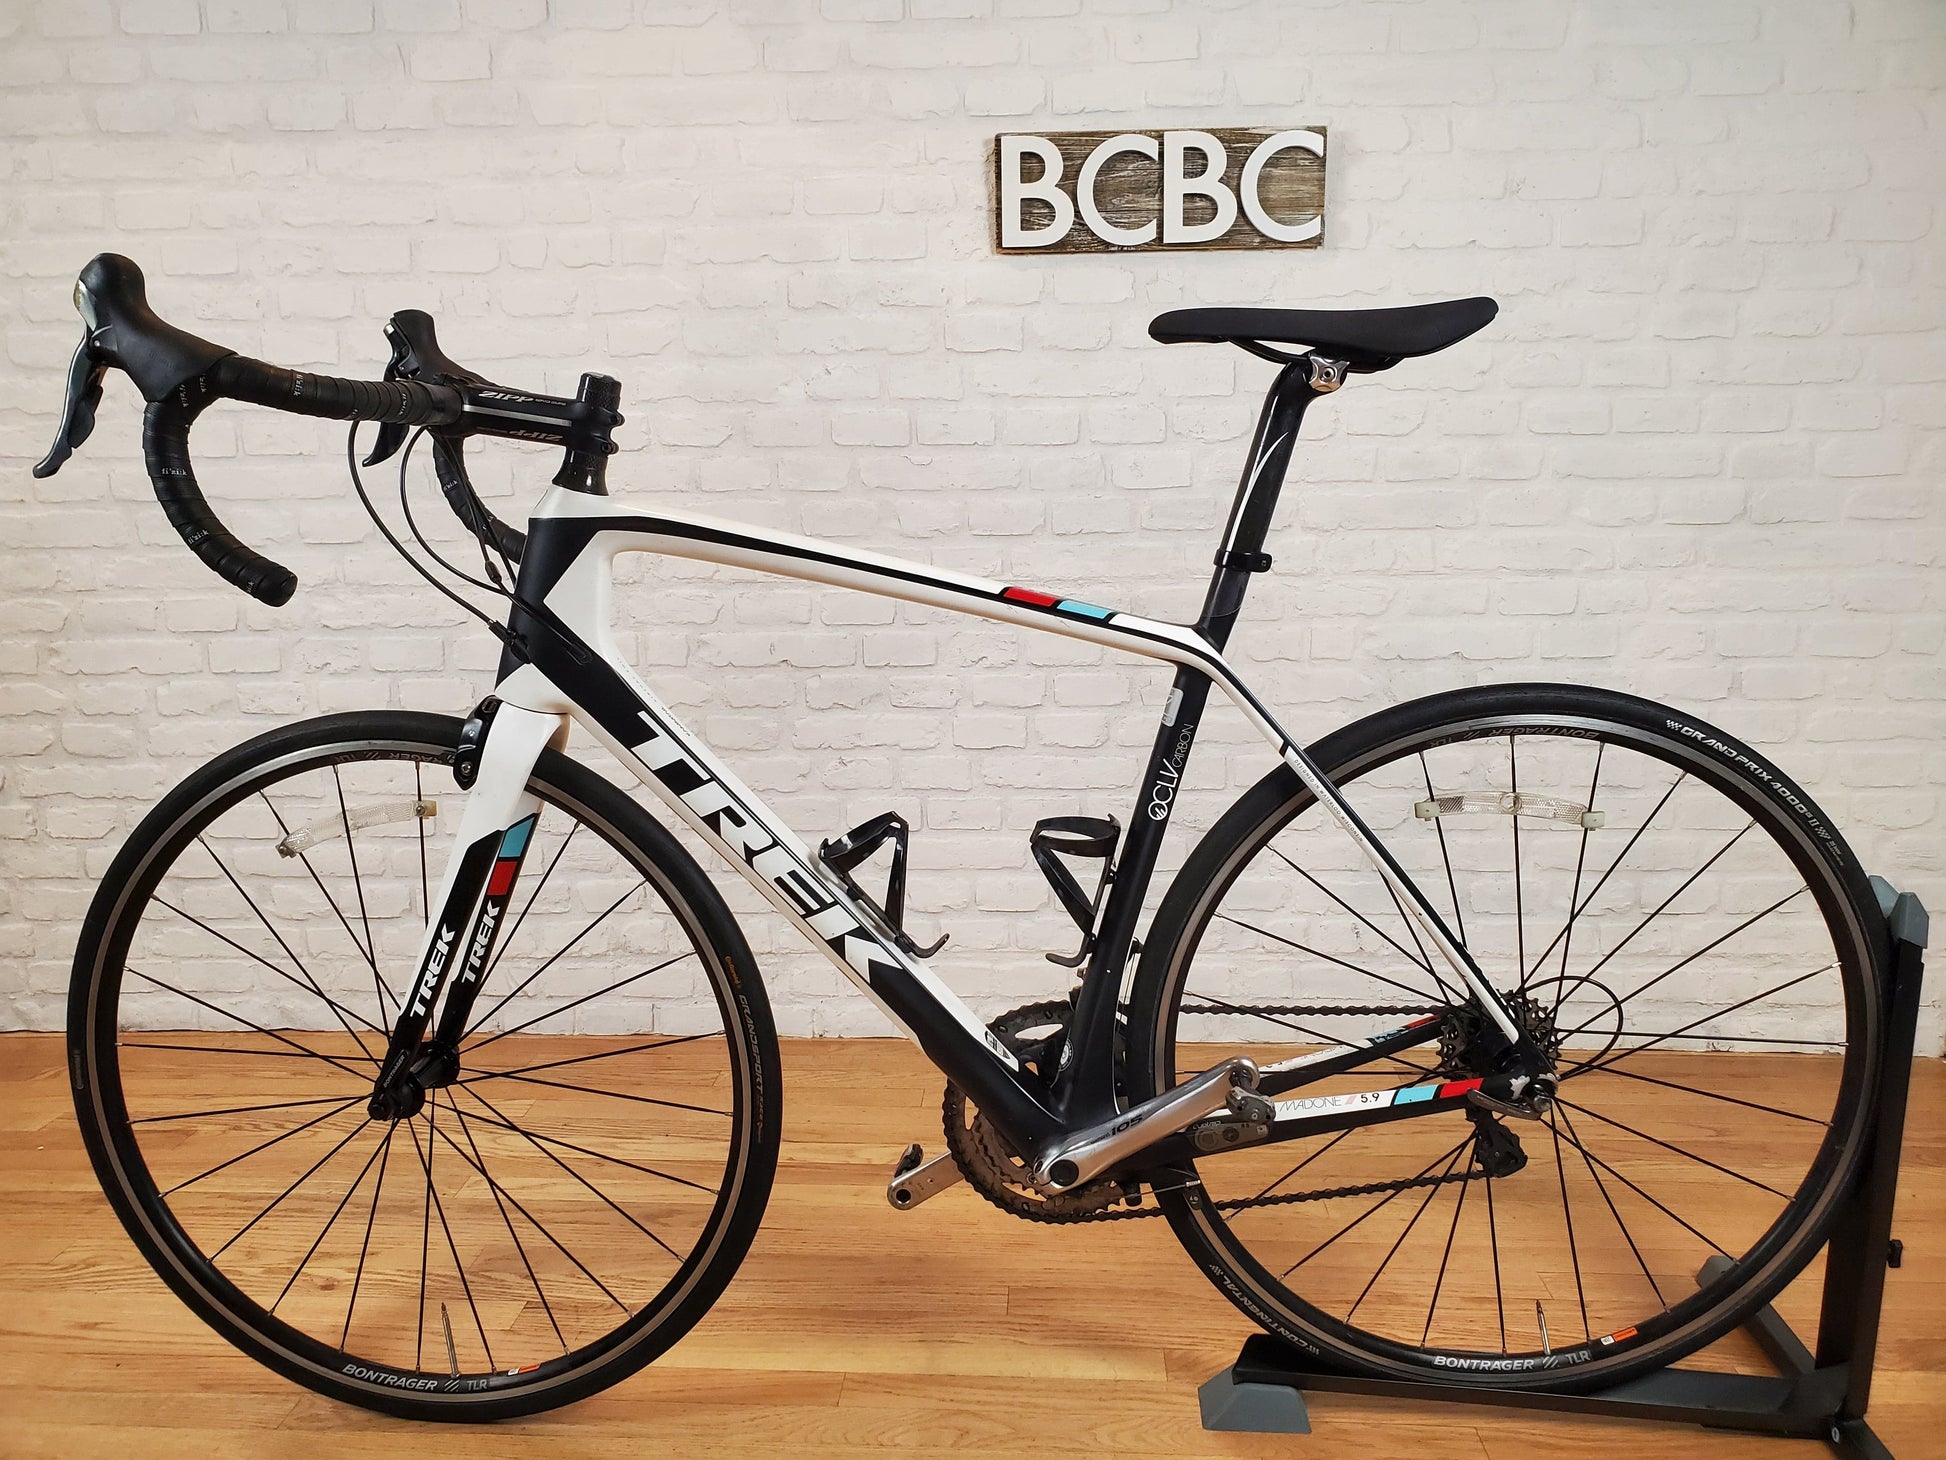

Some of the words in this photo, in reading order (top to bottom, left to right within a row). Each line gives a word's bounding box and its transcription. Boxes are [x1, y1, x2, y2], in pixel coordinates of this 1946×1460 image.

[1001, 130, 1324, 247] BCBC
[478, 390, 534, 403] ZIPP
[508, 429, 564, 442] ZIPP
[1172, 723, 1195, 768] CARBON
[1488, 727, 1600, 740] BONTRAGER
[1680, 726, 1738, 759] GRAND
[1734, 753, 1773, 782] PRIX
[1294, 759, 1315, 783] DESIGNED
[630, 710, 904, 985] TREK
[462, 899, 501, 983] TREK
[409, 922, 456, 1018] TREK
[1280, 1097, 1342, 1112] MADONE
[1360, 1092, 1380, 1104] 5.9
[1111, 1114, 1144, 1136] 105
[1222, 1275, 1309, 1349] CONTINENTAL
[1433, 1355, 1535, 1371] BONTRAGER
[1565, 1350, 1592, 1366] TLR
[341, 1363, 438, 1392] BONTRAGER
[466, 1379, 488, 1391] TLR
